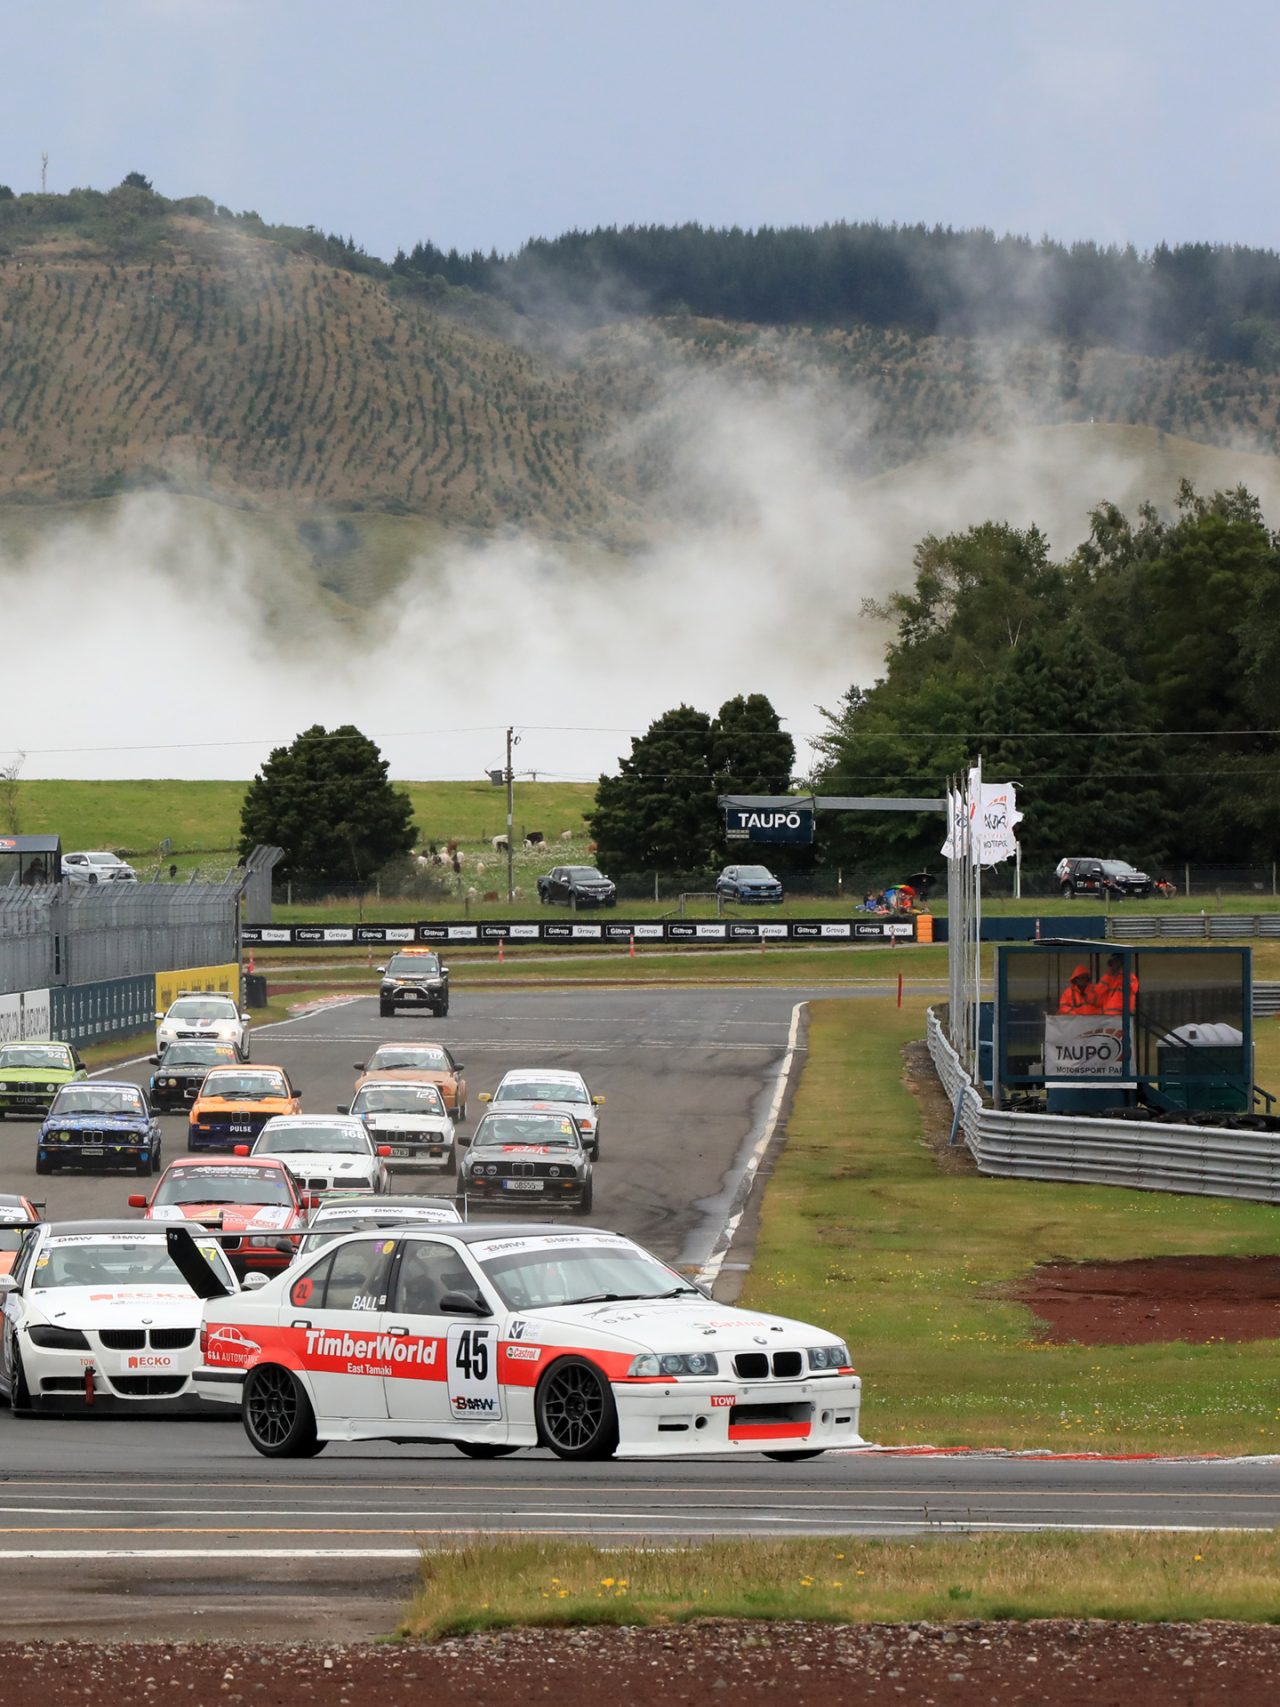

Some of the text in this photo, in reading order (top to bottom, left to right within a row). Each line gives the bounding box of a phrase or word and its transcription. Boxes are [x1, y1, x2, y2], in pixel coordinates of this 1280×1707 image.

[738, 811, 801, 829] TAUPŌ
[825, 926, 845, 934] Group
[1056, 1042, 1112, 1061] TAUPŌ
[352, 1295, 378, 1311] BALL
[305, 1329, 438, 1365] TimberWorld
[514, 1348, 537, 1359] Castrol
[140, 1357, 171, 1366] ECKO
[455, 1329, 489, 1381] 45
[347, 1362, 393, 1376] East Tamaki
[452, 1396, 497, 1410] BMW
[713, 1397, 735, 1406] TOW
